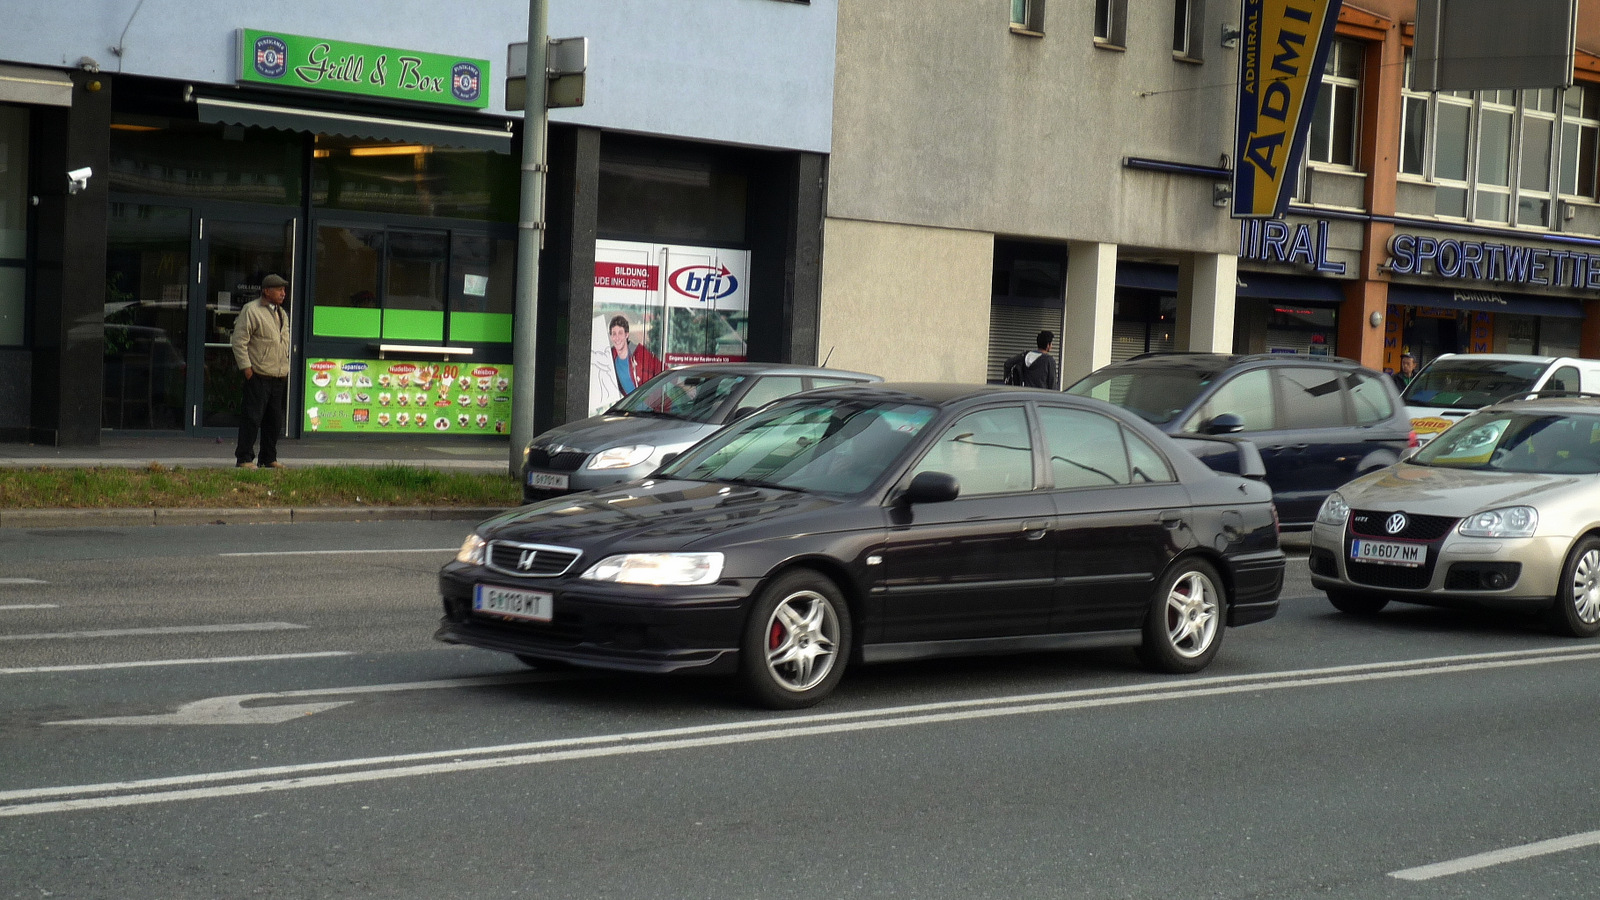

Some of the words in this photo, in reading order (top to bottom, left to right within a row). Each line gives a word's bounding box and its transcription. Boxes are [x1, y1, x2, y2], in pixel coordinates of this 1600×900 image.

[1245, 10, 1258, 94] ADMIRAL
[294, 43, 364, 83] Grill
[369, 54, 387, 87] &
[398, 56, 444, 93] Box
[1247, 0, 1316, 182] ADMI
[1238, 219, 1346, 274] IRAL
[614, 266, 650, 278] BILDUNG.
[611, 277, 649, 288] INKLUSIVE.
[685, 272, 722, 302] bfi
[309, 362, 336, 371] Vorspeisen
[342, 363, 368, 371] Japanisch
[432, 365, 459, 382] 2,80
[1364, 542, 1371, 556] G
[1379, 544, 1400, 558] 607
[1402, 546, 1419, 560] NM
